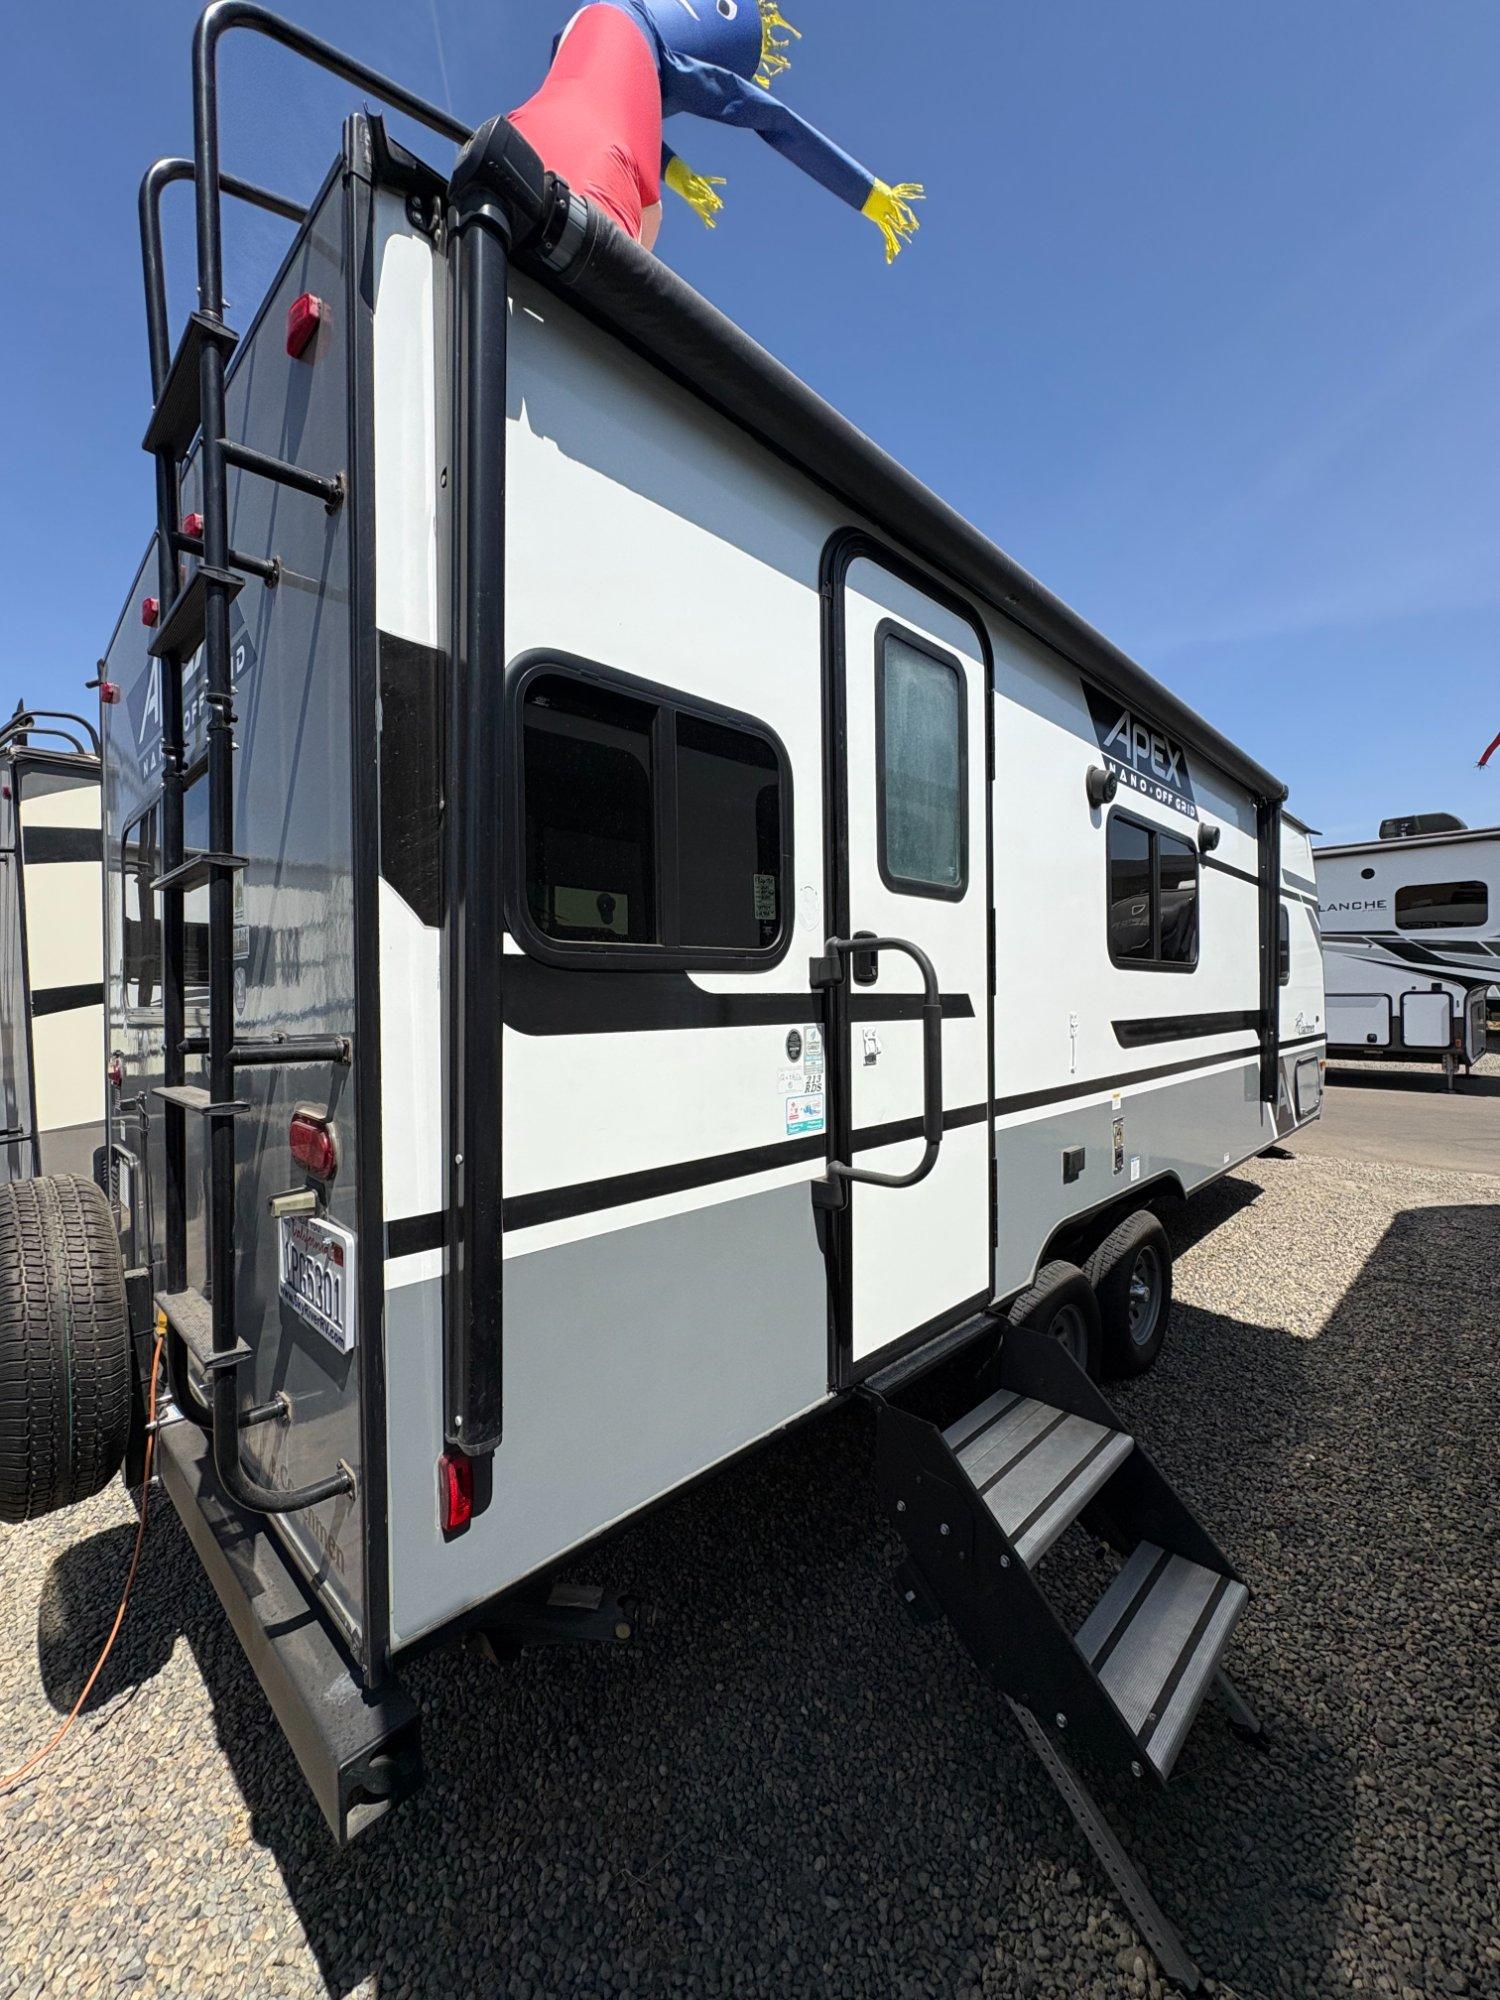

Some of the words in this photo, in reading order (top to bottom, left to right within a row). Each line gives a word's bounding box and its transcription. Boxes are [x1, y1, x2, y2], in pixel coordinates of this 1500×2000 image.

[1103, 710, 1181, 788] APEX
[1109, 762, 1147, 791] NANO
[1156, 788, 1174, 806] OFF
[1175, 798, 1196, 817] GRID
[1318, 899, 1387, 912] LANCHE
